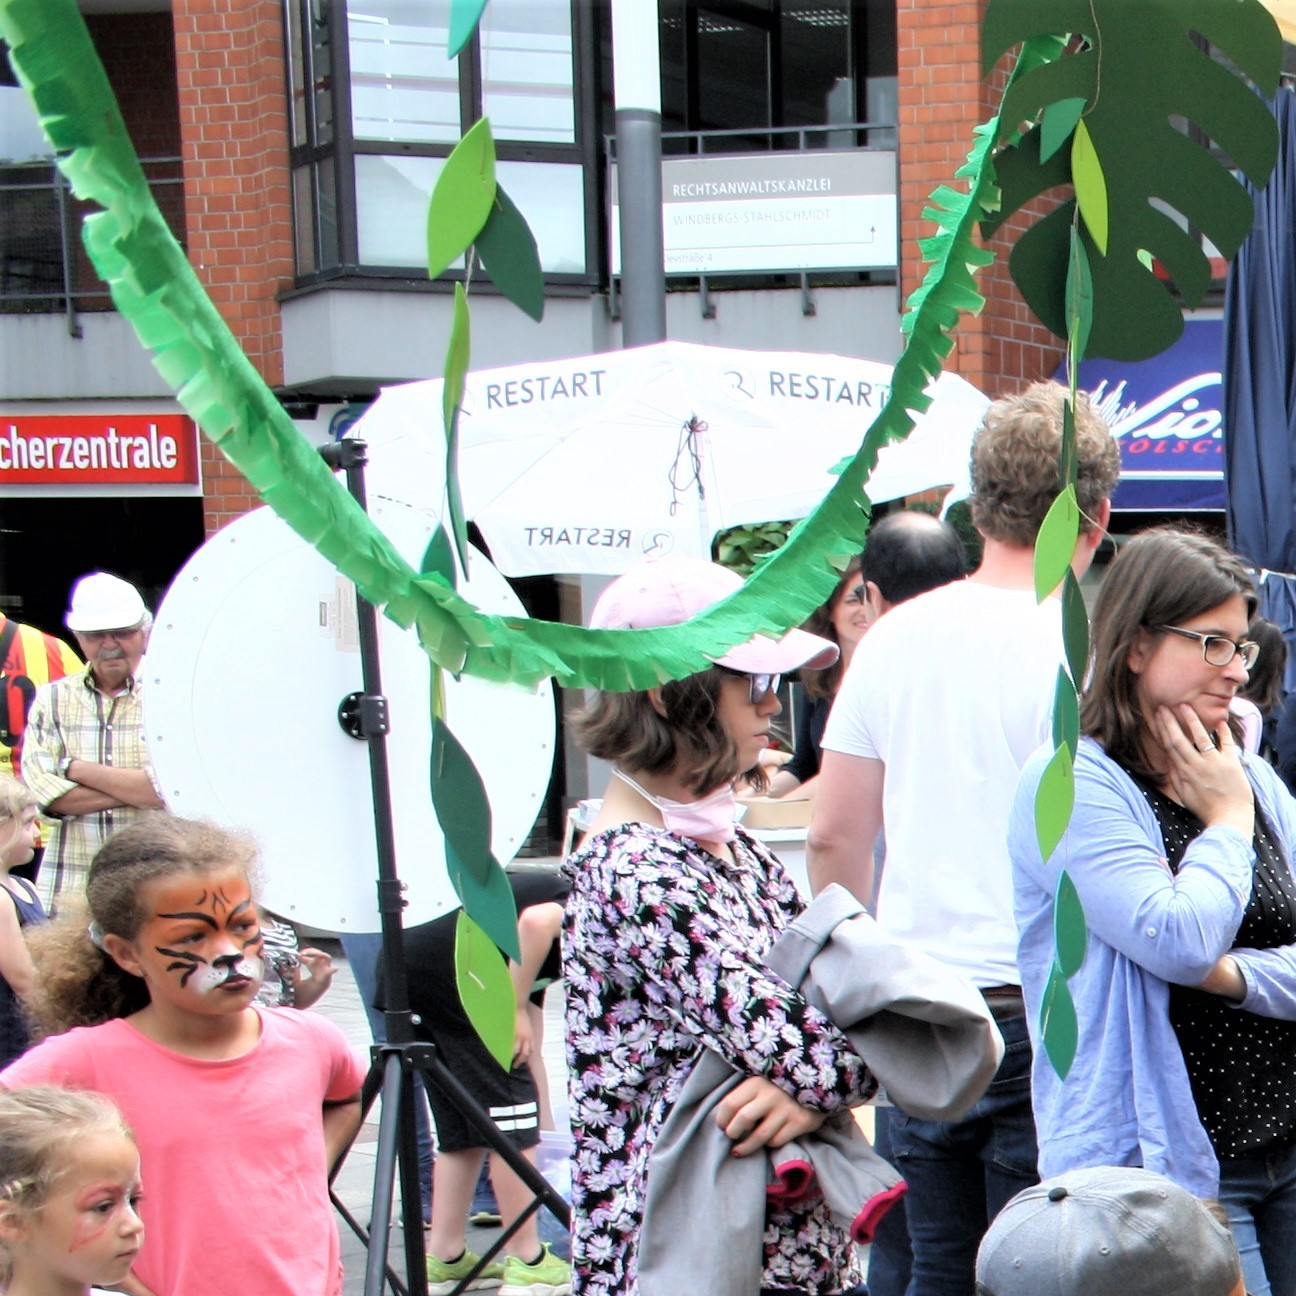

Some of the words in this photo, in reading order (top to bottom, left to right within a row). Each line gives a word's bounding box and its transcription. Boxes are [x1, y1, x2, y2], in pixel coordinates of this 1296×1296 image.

[672, 177, 831, 198] RECHTSANWALTSKANZLEI
[673, 208, 830, 226] WINDBERGS-STAHLSCHMIDT
[486, 369, 607, 411] RESTART
[1109, 371, 1222, 440] Sio
